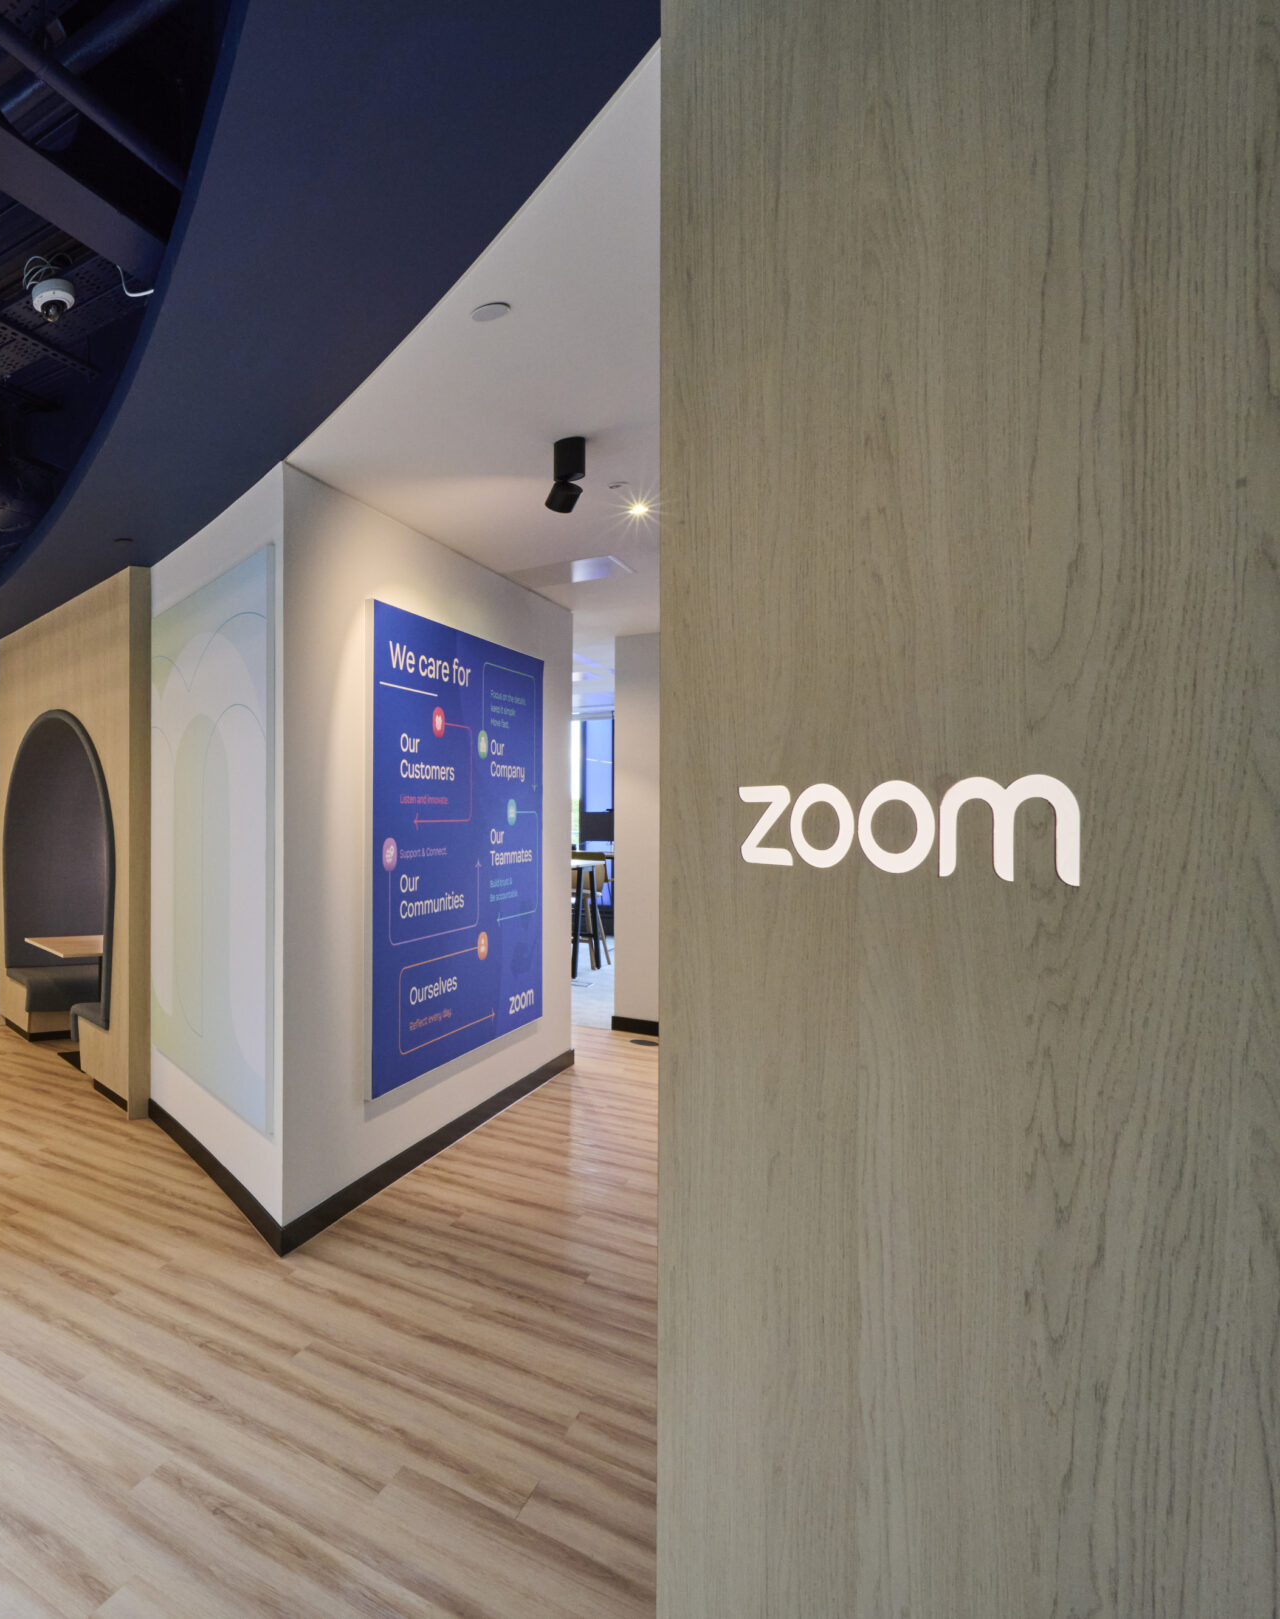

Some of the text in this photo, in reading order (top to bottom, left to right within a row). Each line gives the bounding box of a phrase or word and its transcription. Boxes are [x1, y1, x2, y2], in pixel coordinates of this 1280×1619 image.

[389, 640, 471, 687] We care for
[400, 733, 420, 753] Our
[490, 739, 505, 756] Our
[400, 759, 455, 782] Customers
[490, 761, 525, 783] Company
[490, 828, 505, 845] Our
[738, 774, 1081, 887] zoom
[490, 848, 533, 866] Teammates
[400, 874, 420, 893] Our
[400, 891, 465, 919] Communities
[409, 976, 458, 1006] Ourselves
[509, 988, 535, 1015] zoom
